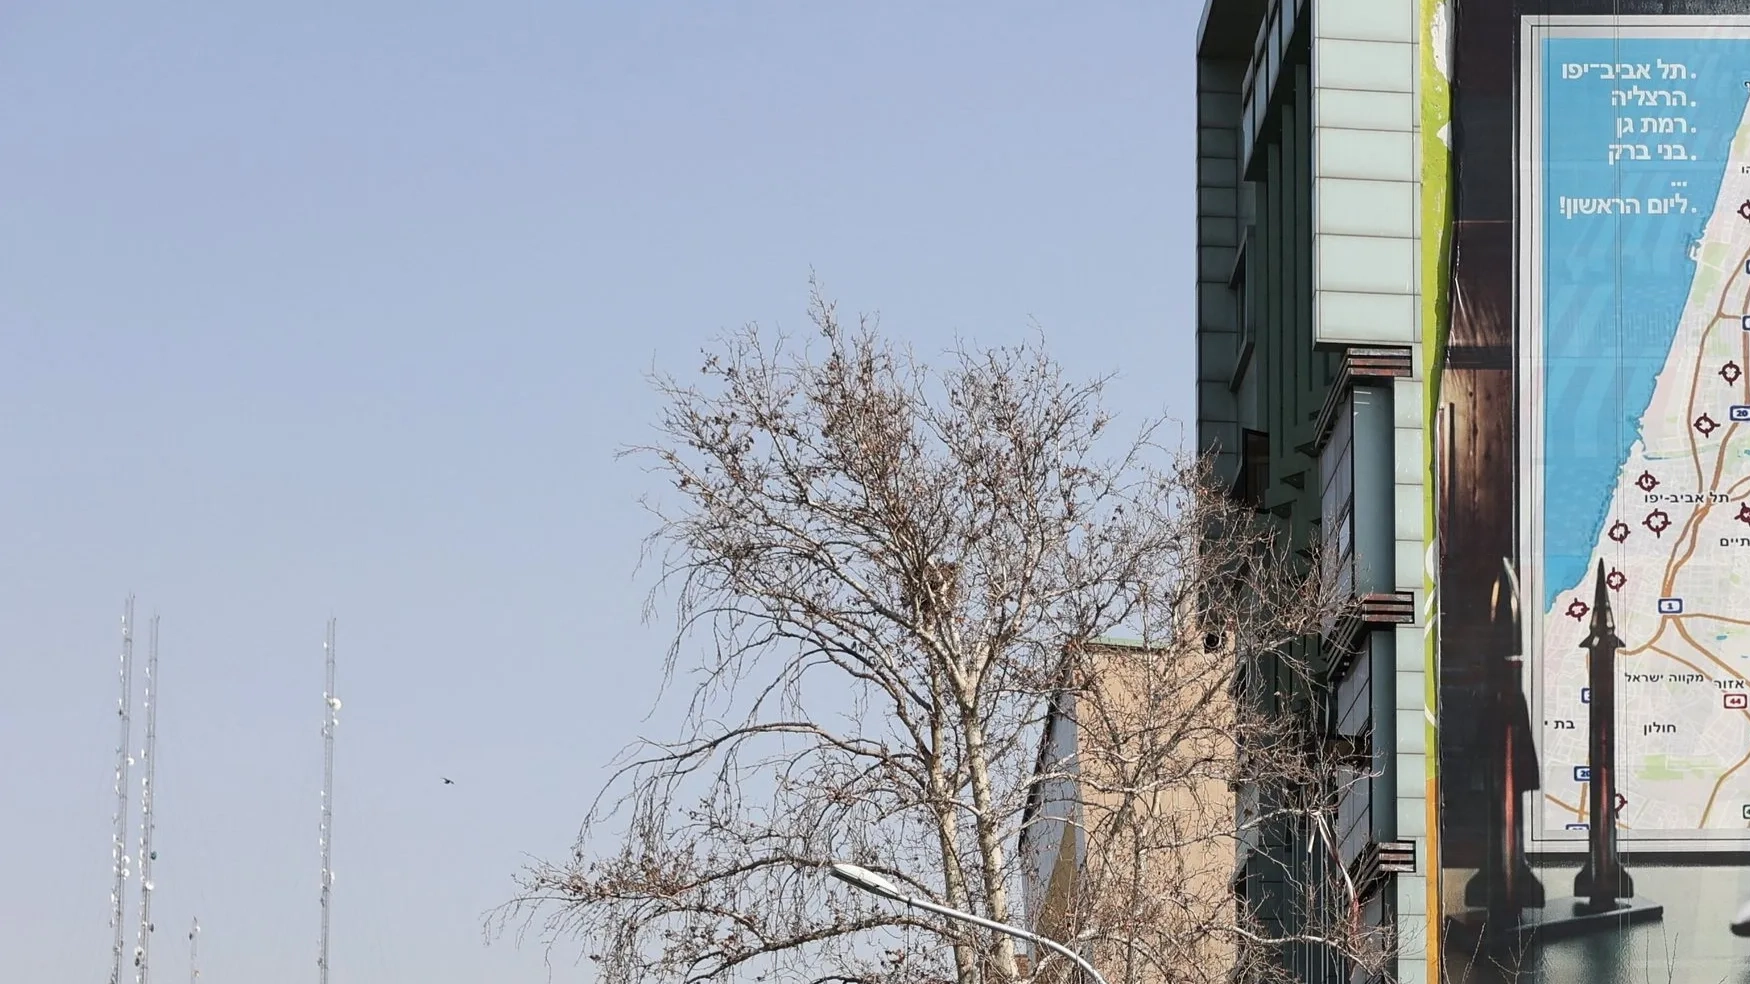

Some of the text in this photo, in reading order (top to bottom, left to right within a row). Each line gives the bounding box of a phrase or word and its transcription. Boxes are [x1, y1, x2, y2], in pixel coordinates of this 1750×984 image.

[1657, 59, 1687, 79] תל
[1611, 87, 1687, 107] הרצליה
[1616, 117, 1687, 138] רמת גן
[1608, 145, 1687, 165] בני ברק
[1559, 194, 1687, 219] ליום הראשון!
[1709, 492, 1729, 503] תל
[1624, 672, 1704, 684] מקווה ישראל
[1714, 679, 1745, 689] אזור
[1554, 720, 1575, 730] בת
[1643, 722, 1677, 736] חולון
